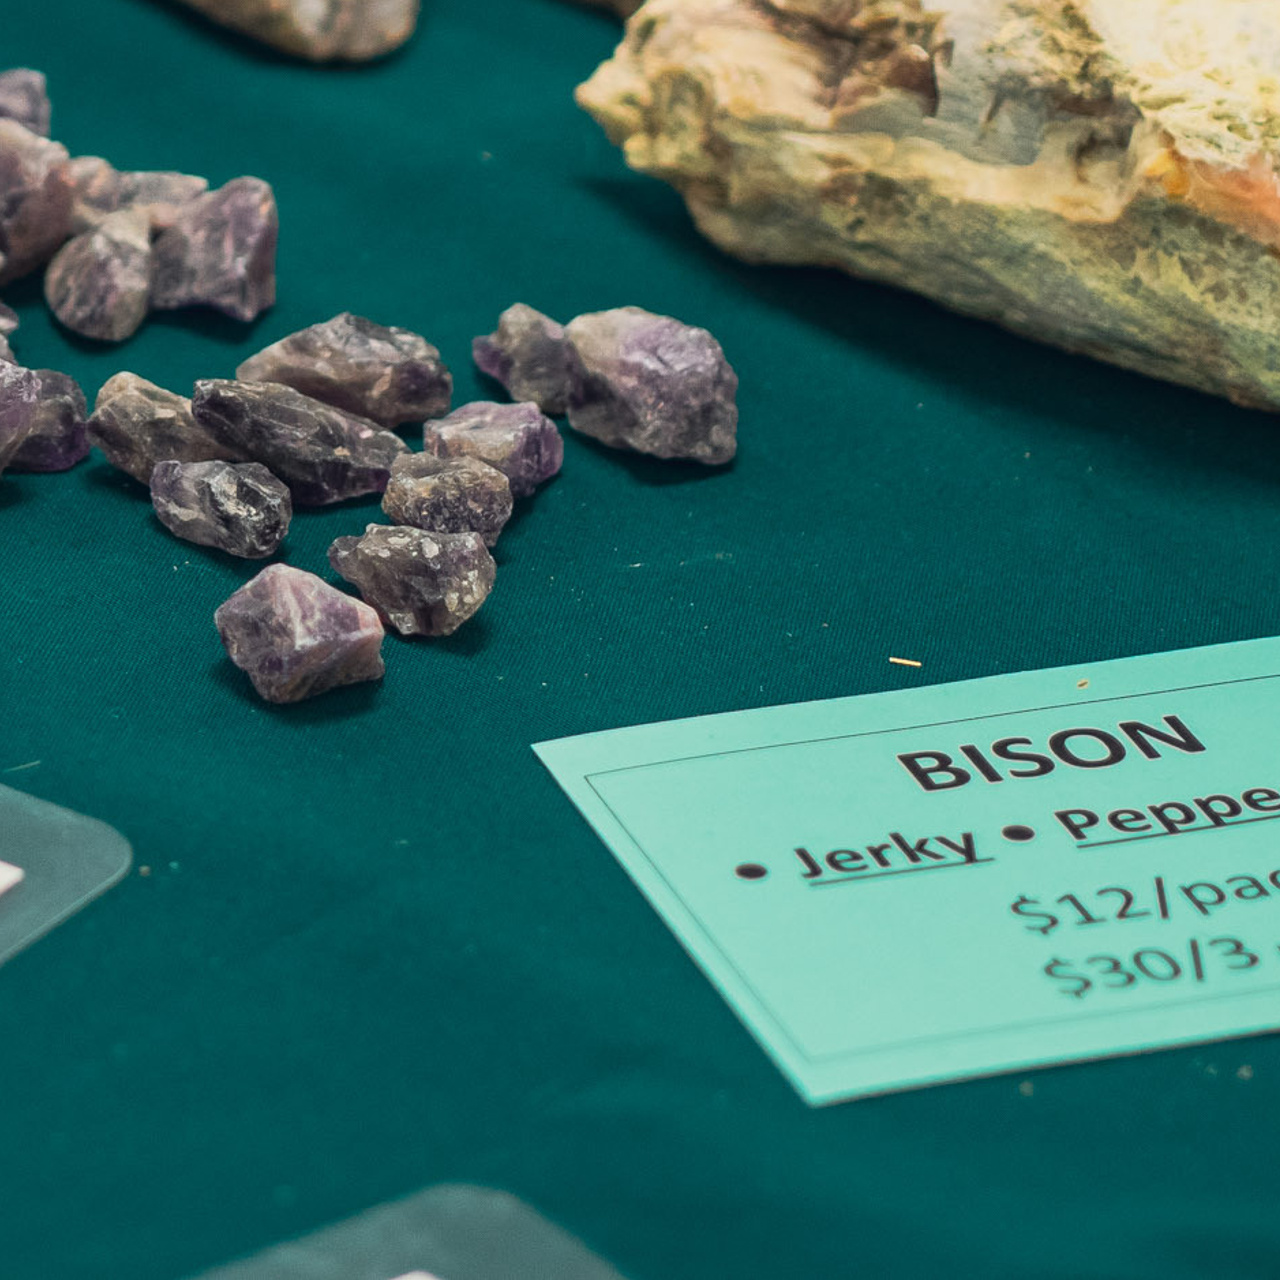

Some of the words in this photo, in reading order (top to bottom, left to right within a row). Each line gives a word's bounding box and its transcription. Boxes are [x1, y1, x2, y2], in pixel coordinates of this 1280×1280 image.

[896, 714, 1207, 792] BISON
[793, 831, 982, 879] Jerky
[1043, 937, 1260, 998] $30/3
